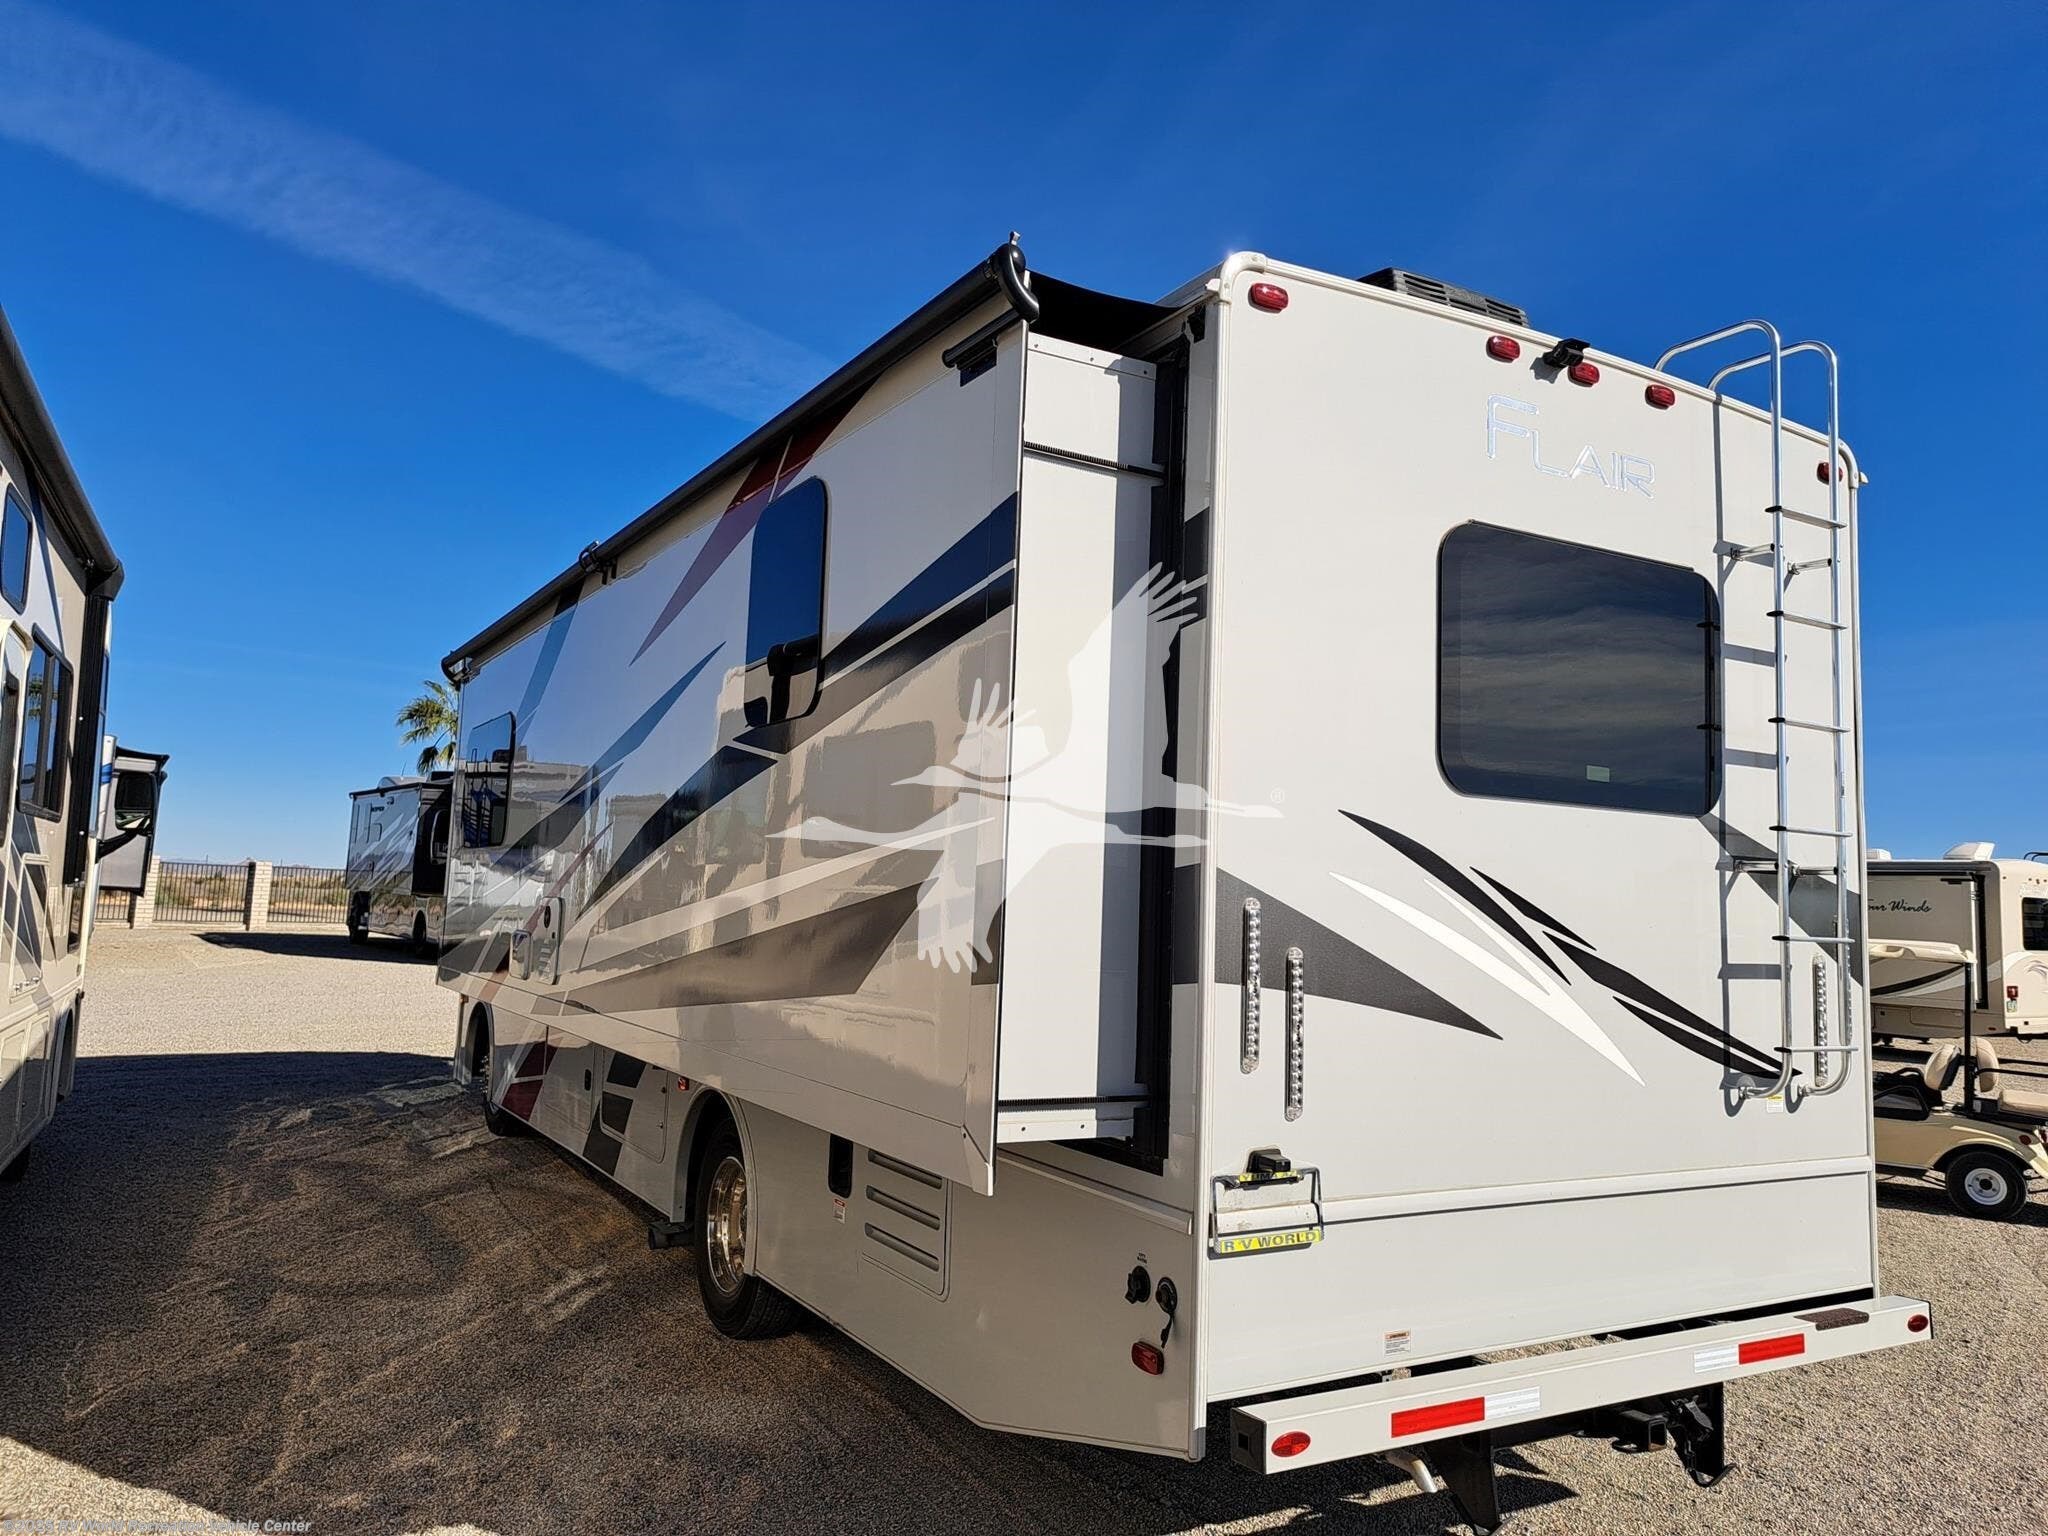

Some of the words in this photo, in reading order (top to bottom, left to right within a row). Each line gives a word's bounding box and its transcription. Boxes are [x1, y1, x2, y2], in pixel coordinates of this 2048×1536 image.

[1487, 393, 1656, 500] FLAIR
[1888, 898, 1932, 912] Winds
[1258, 1231, 1318, 1248] WORLD
